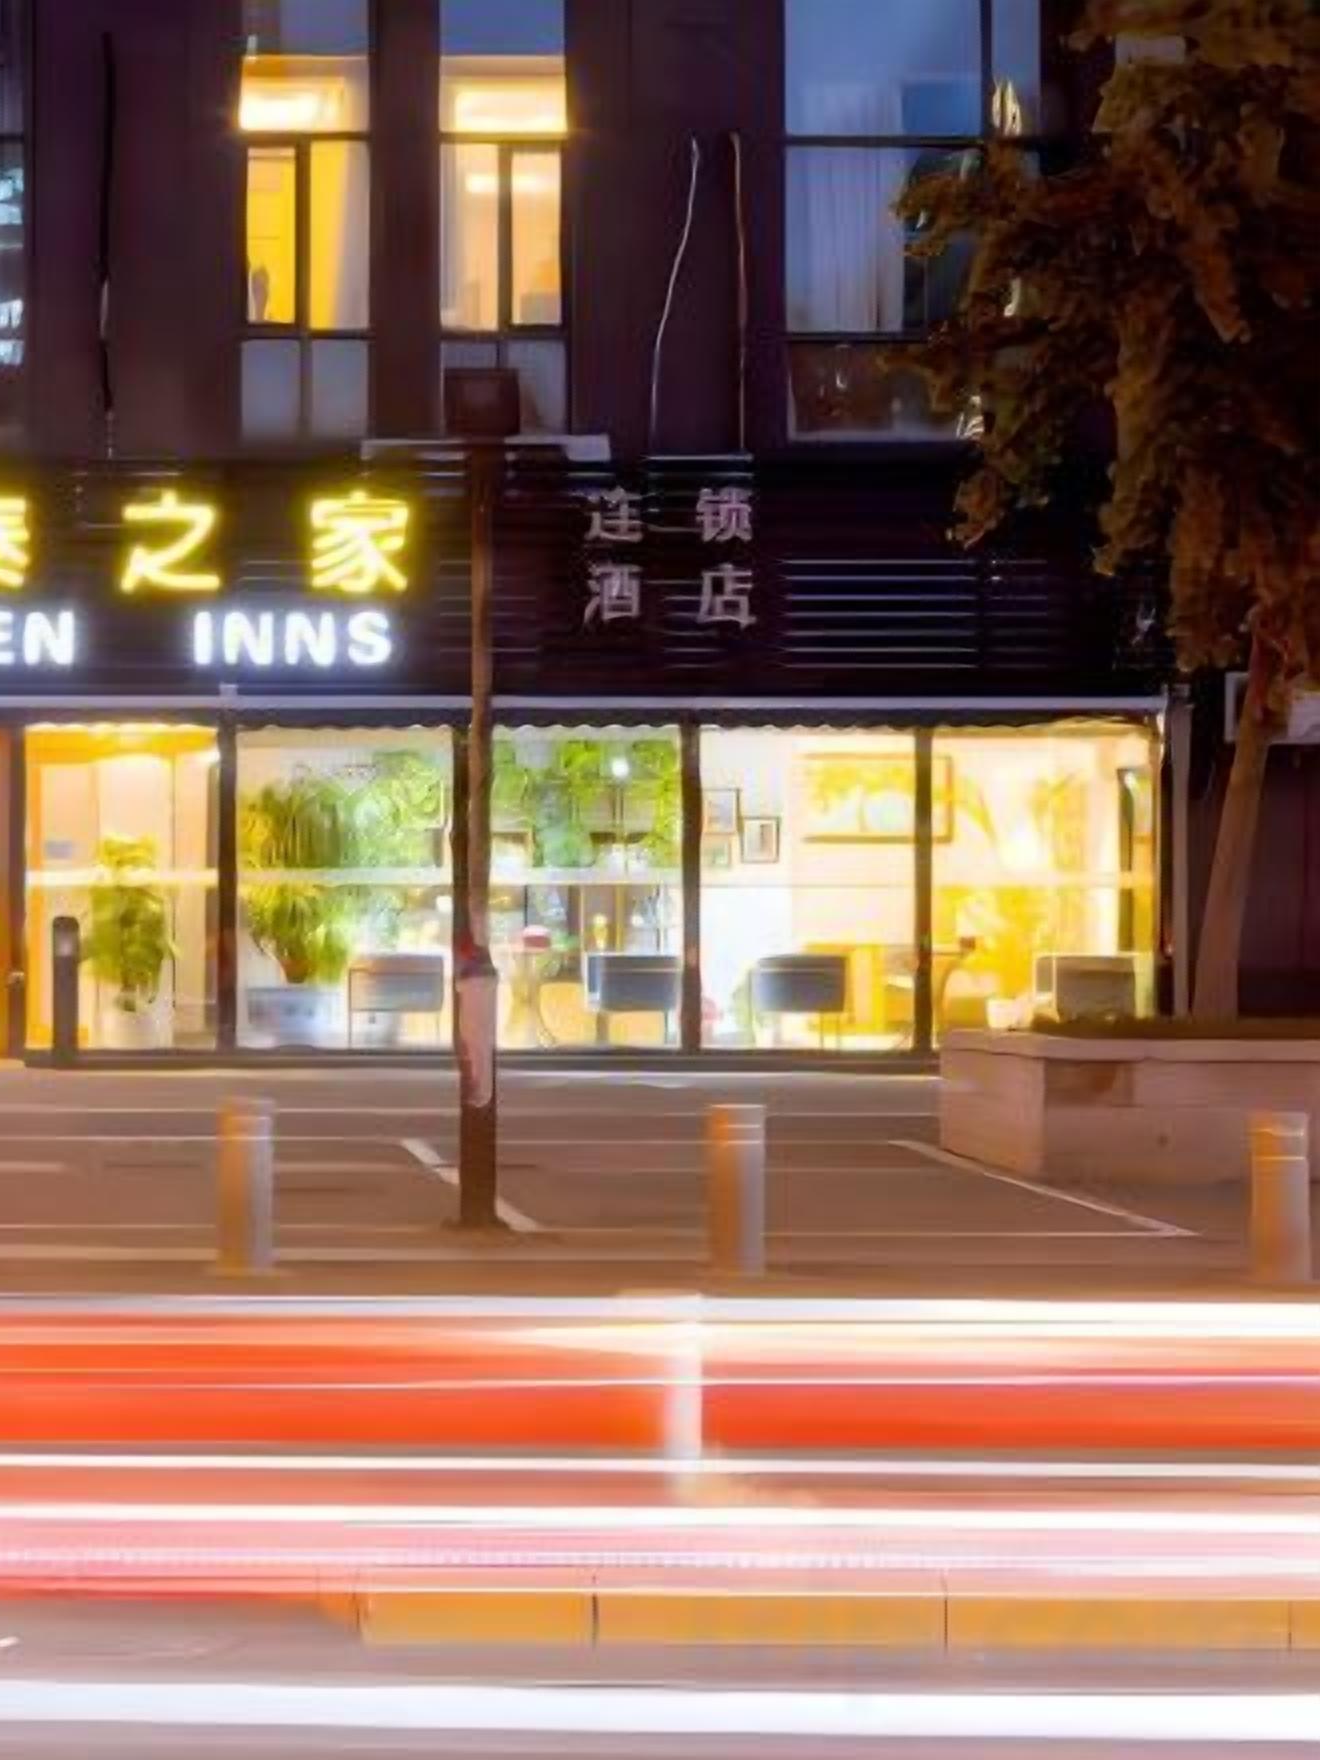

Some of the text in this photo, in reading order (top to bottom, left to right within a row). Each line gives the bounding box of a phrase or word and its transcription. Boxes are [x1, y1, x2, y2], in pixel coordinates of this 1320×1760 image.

[583, 486, 752, 542] 连锁
[583, 562, 757, 629] 酒店
[192, 611, 393, 667] INNS
